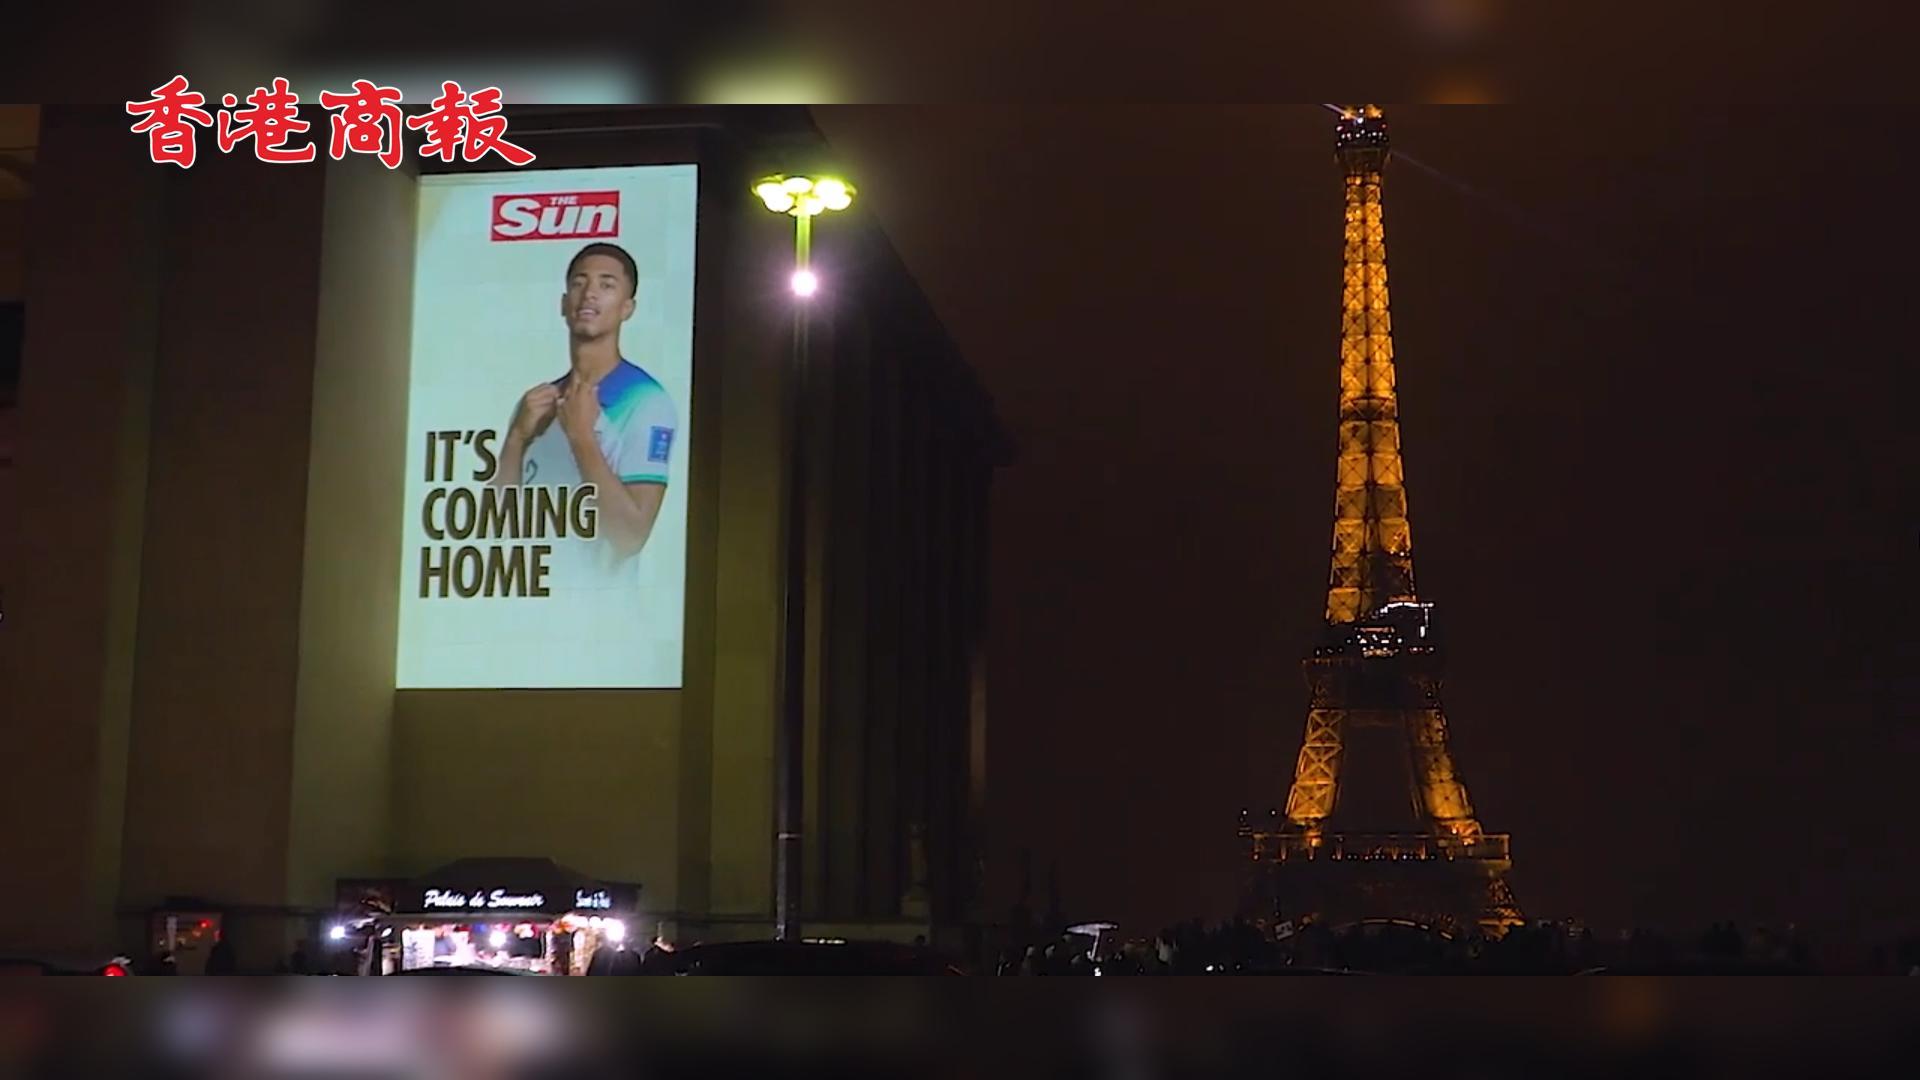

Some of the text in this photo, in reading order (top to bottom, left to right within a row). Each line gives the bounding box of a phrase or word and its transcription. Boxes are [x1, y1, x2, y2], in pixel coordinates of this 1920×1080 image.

[493, 198, 618, 237] Sun
[549, 196, 579, 205] THE
[424, 429, 497, 482] IT'S
[421, 485, 597, 540] COMING
[419, 545, 551, 598] HOME
